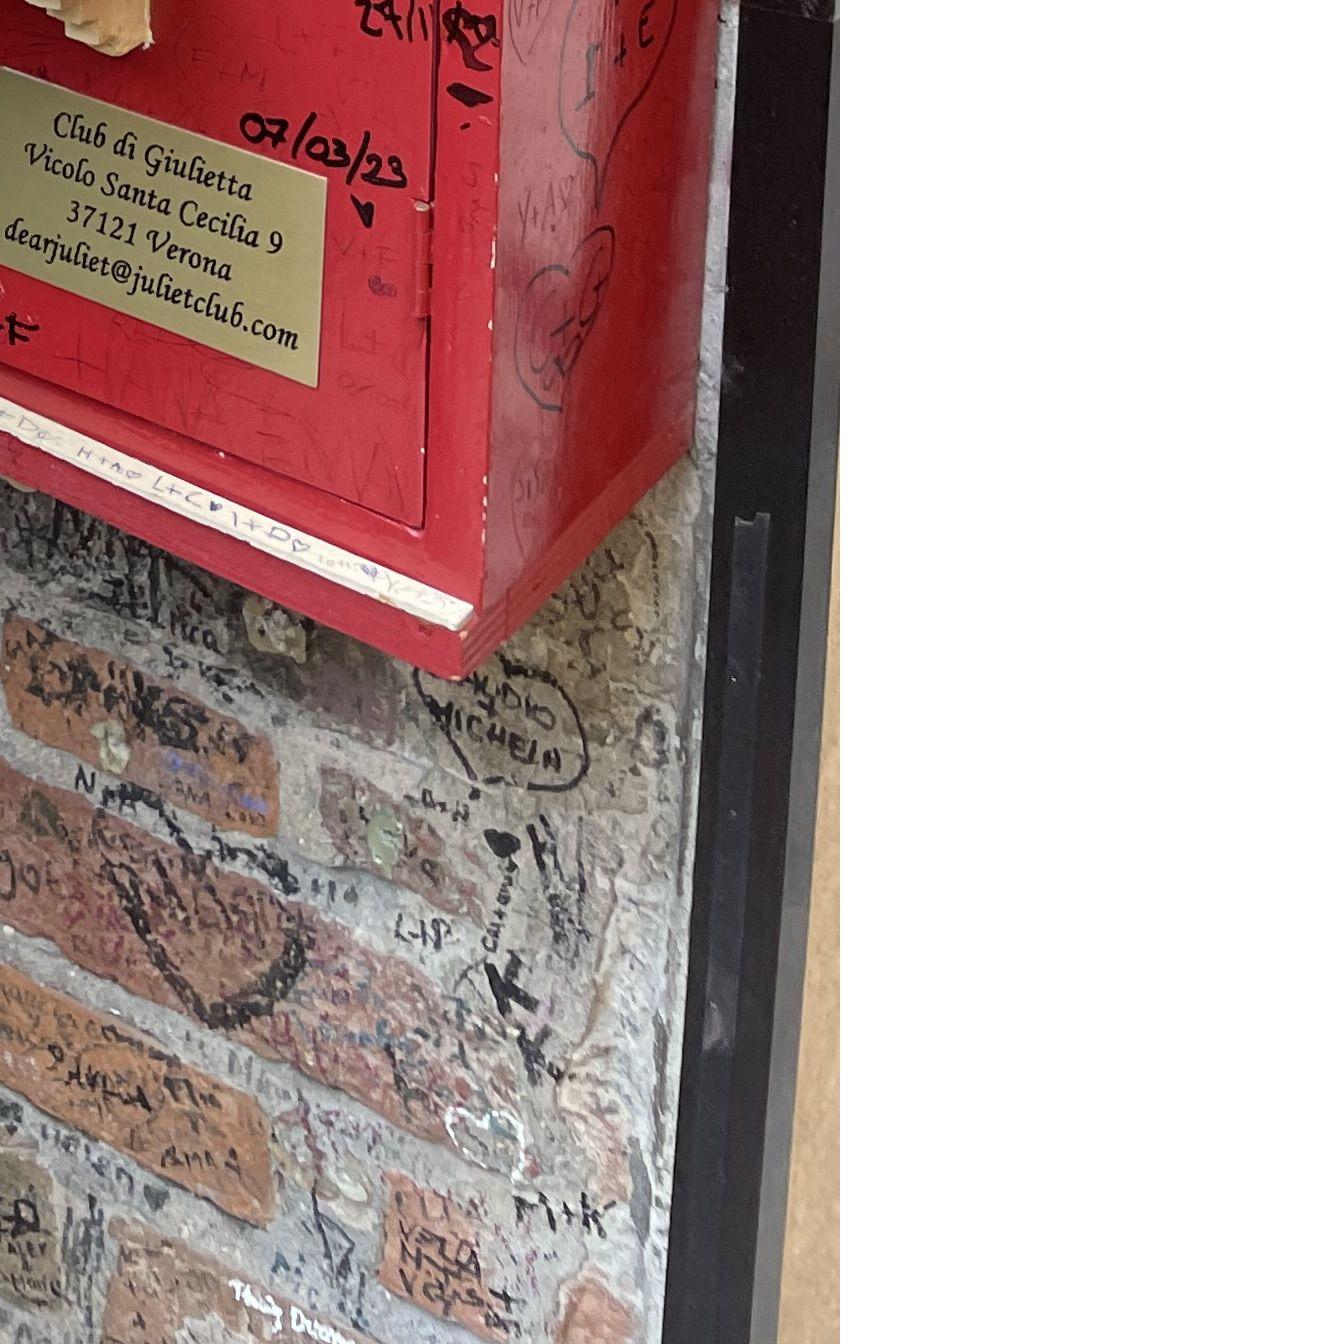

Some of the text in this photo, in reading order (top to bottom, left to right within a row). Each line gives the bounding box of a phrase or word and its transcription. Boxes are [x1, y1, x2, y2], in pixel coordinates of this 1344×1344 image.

[53, 111, 253, 202] Club di Giulietta
[239, 111, 409, 190] 07/03/23
[23, 141, 284, 255] Vicolo Santa Cecilia 9
[66, 200, 232, 283] 37121 Verona
[3, 218, 300, 351] dearjuliet@julietclub.com
